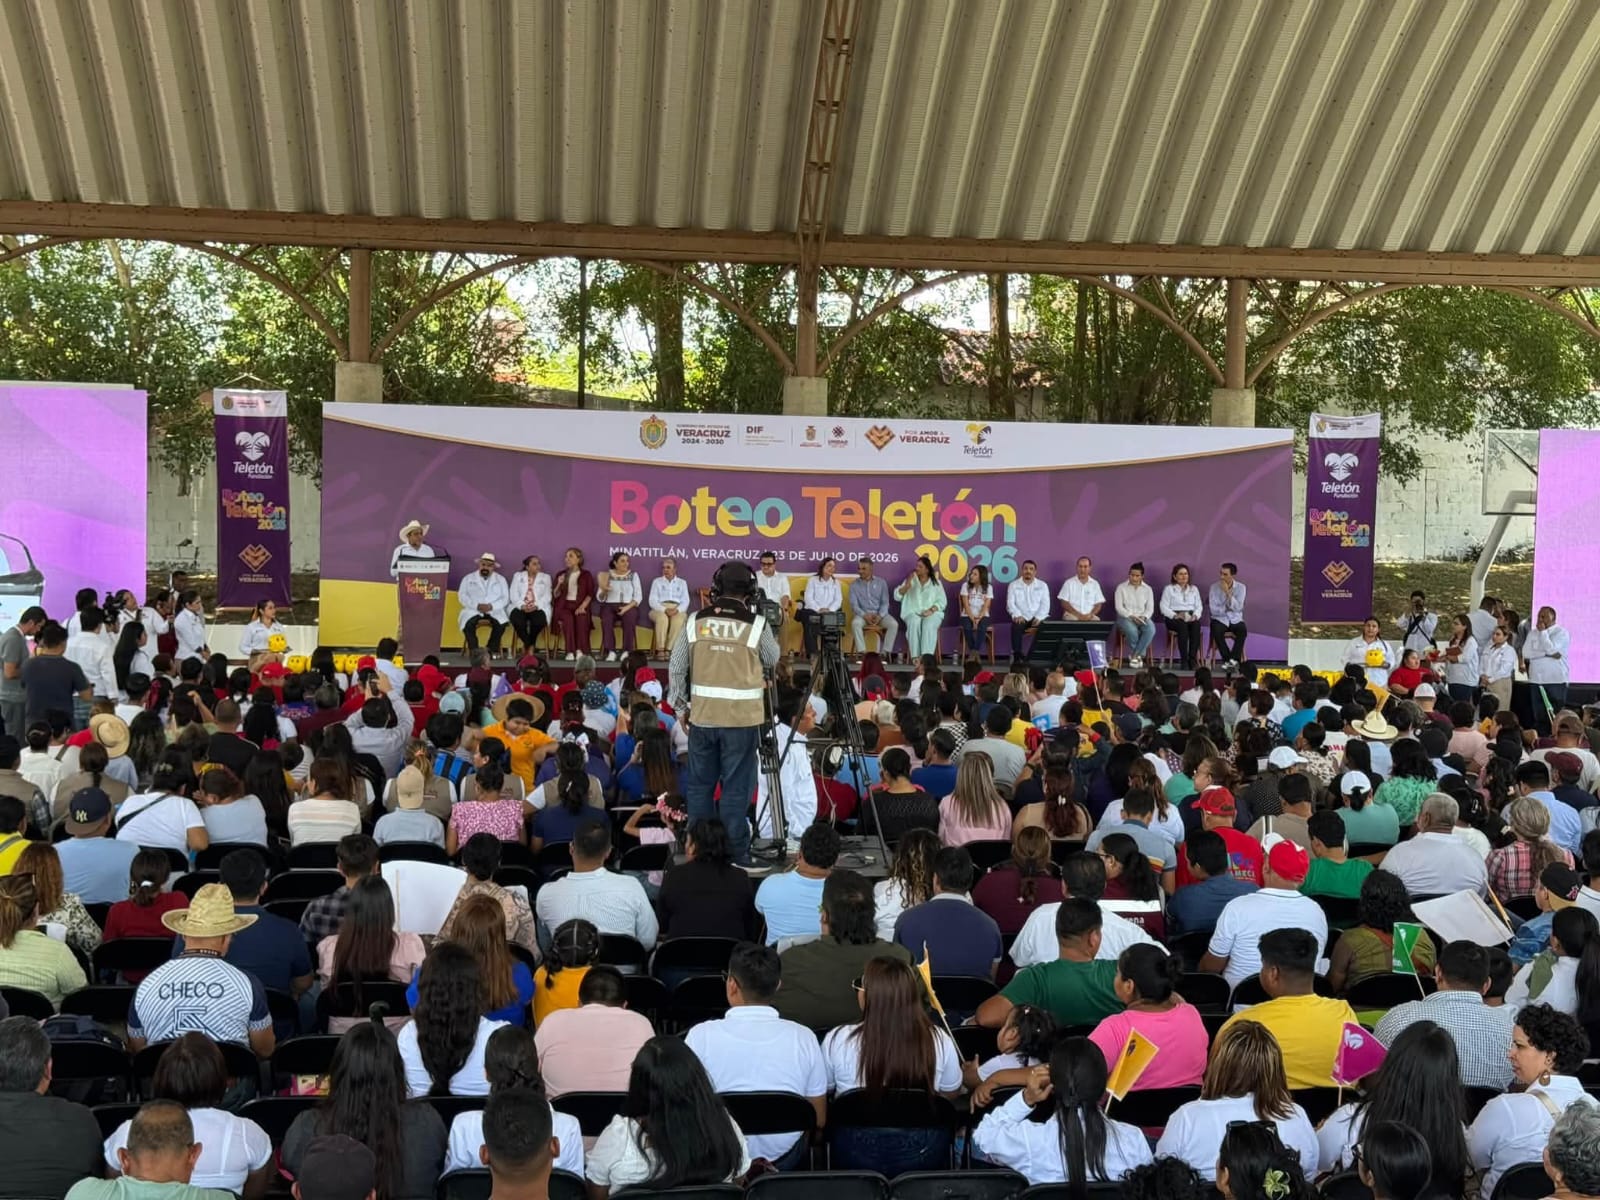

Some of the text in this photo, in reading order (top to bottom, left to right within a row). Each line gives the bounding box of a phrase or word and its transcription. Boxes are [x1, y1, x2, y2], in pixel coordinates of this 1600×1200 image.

[676, 428, 731, 438] VERACRUZ
[746, 426, 764, 434] DIF
[900, 435, 950, 445] VERACRUZ
[963, 445, 993, 455] Teletón
[233, 461, 274, 474] Teletón
[1321, 482, 1360, 494] Teletón
[610, 480, 793, 538] Boteo
[801, 486, 1017, 543] Teletón
[692, 548, 760, 560] VERACRUZ
[771, 550, 786, 560] 23
[789, 551, 806, 560] DE
[870, 552, 899, 562] 2026
[914, 543, 1019, 583] 2026
[707, 619, 747, 640] RTV
[158, 981, 225, 1000] CHECO
